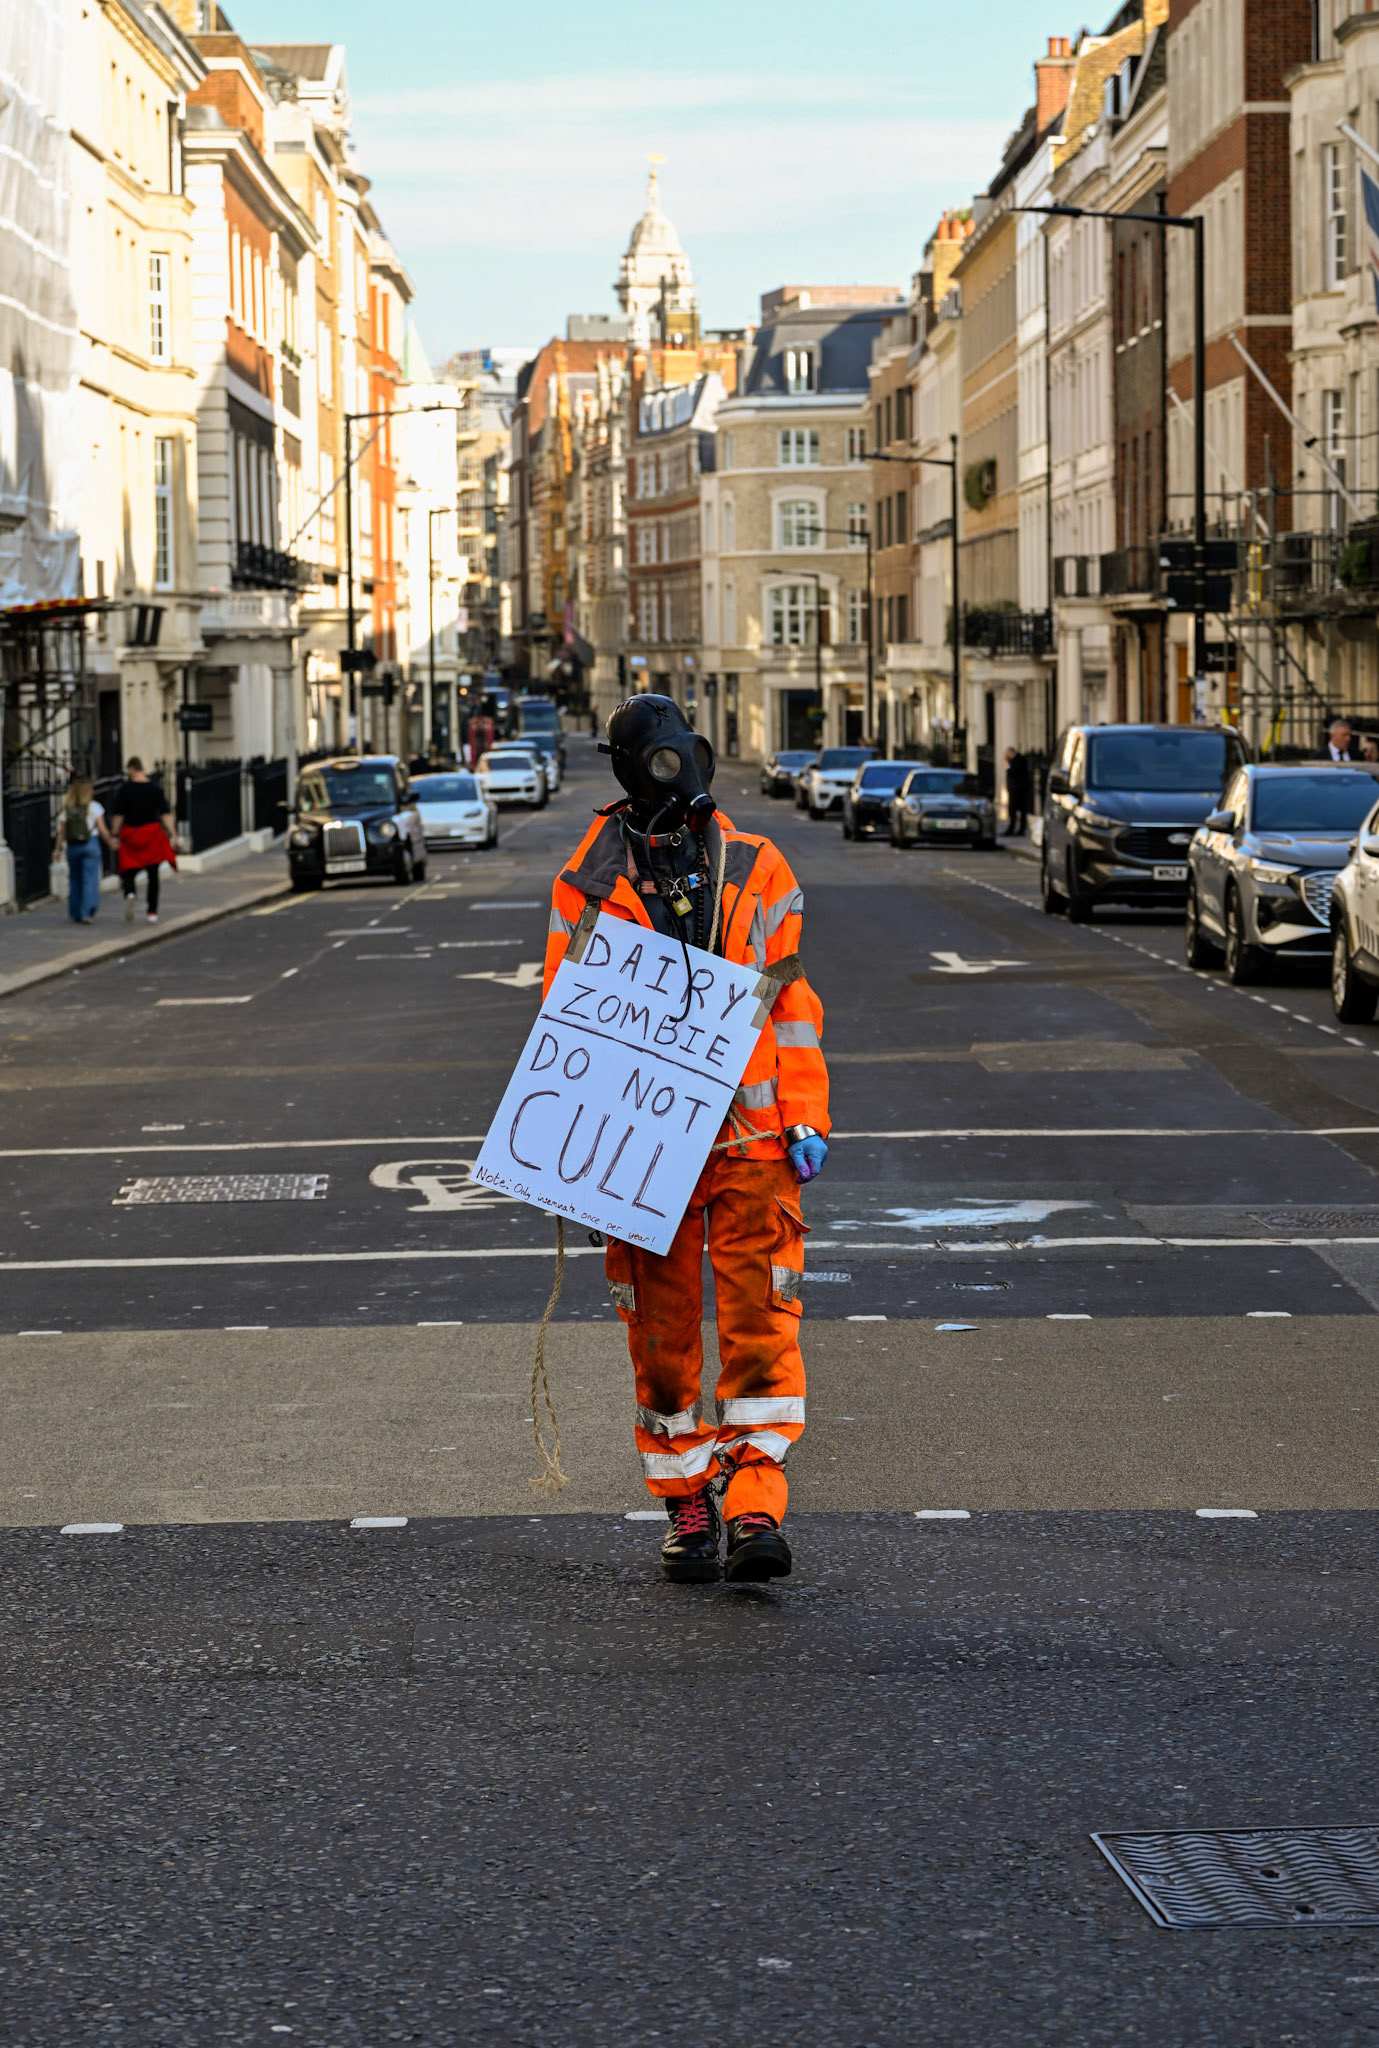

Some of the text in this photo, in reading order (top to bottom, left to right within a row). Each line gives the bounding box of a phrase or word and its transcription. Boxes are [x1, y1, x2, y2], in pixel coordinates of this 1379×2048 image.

[583, 932, 749, 1021] DAIRY
[560, 982, 731, 1068] ZOMBIE
[529, 1032, 712, 1134] DO NOT
[509, 1089, 667, 1219] CULL
[475, 1165, 656, 1247] Note: Only inseminate once per year!
